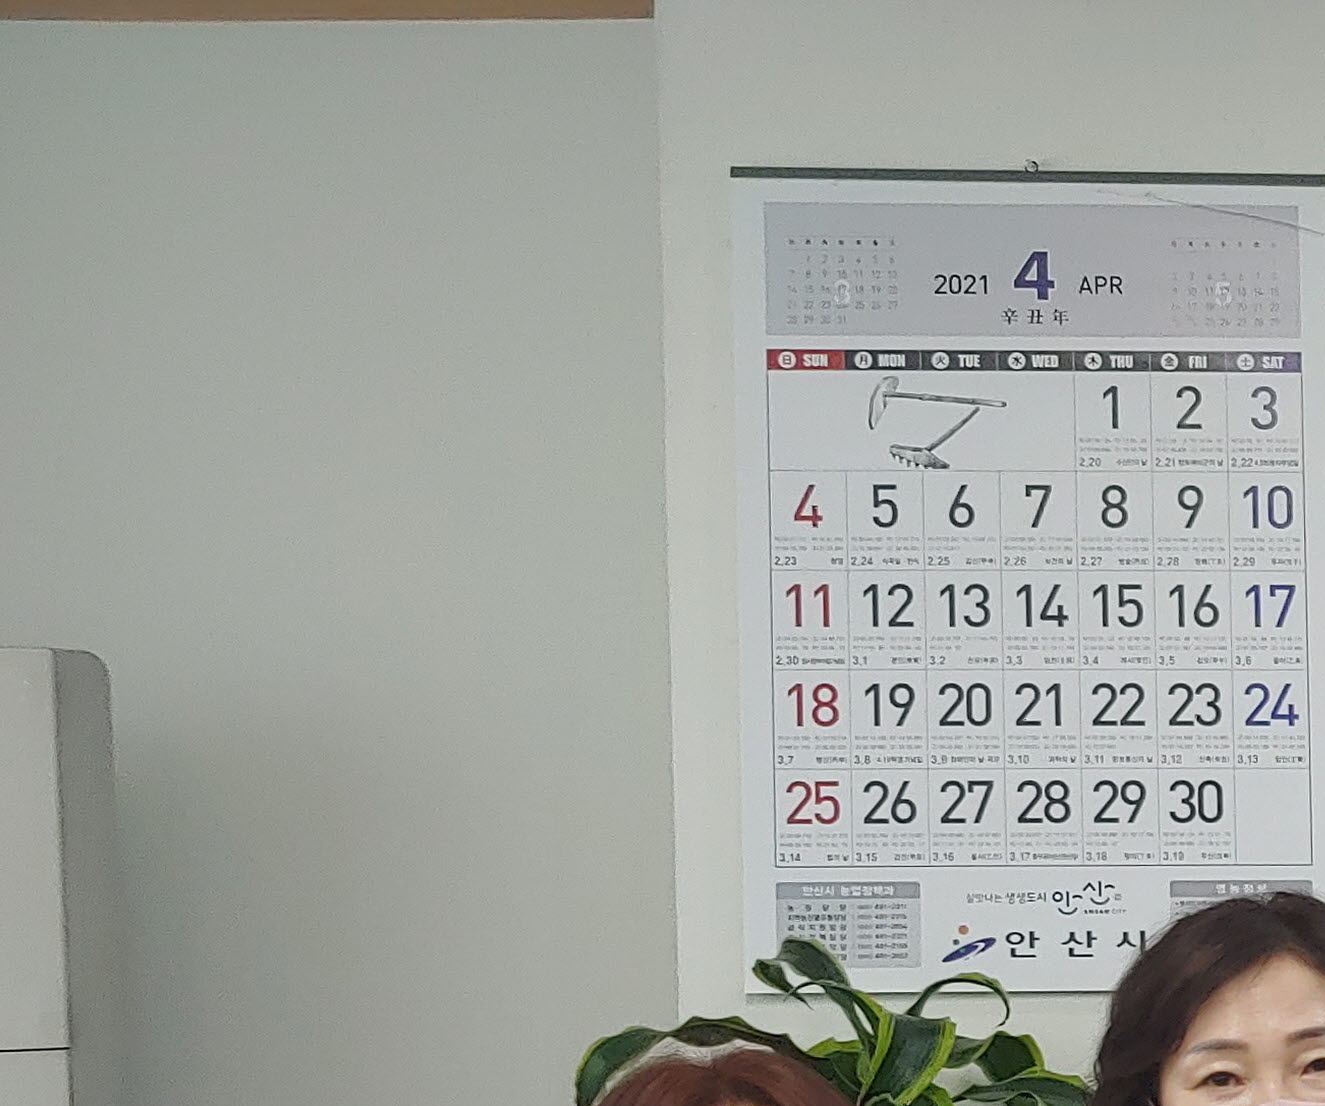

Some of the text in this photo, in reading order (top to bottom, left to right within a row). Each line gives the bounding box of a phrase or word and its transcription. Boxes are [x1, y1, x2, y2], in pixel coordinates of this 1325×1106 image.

[935, 252, 1122, 300] 2021 4 APR
[1103, 386, 1277, 430] 1 2 3
[794, 485, 1293, 529] 4 5 6 7 8 9 10
